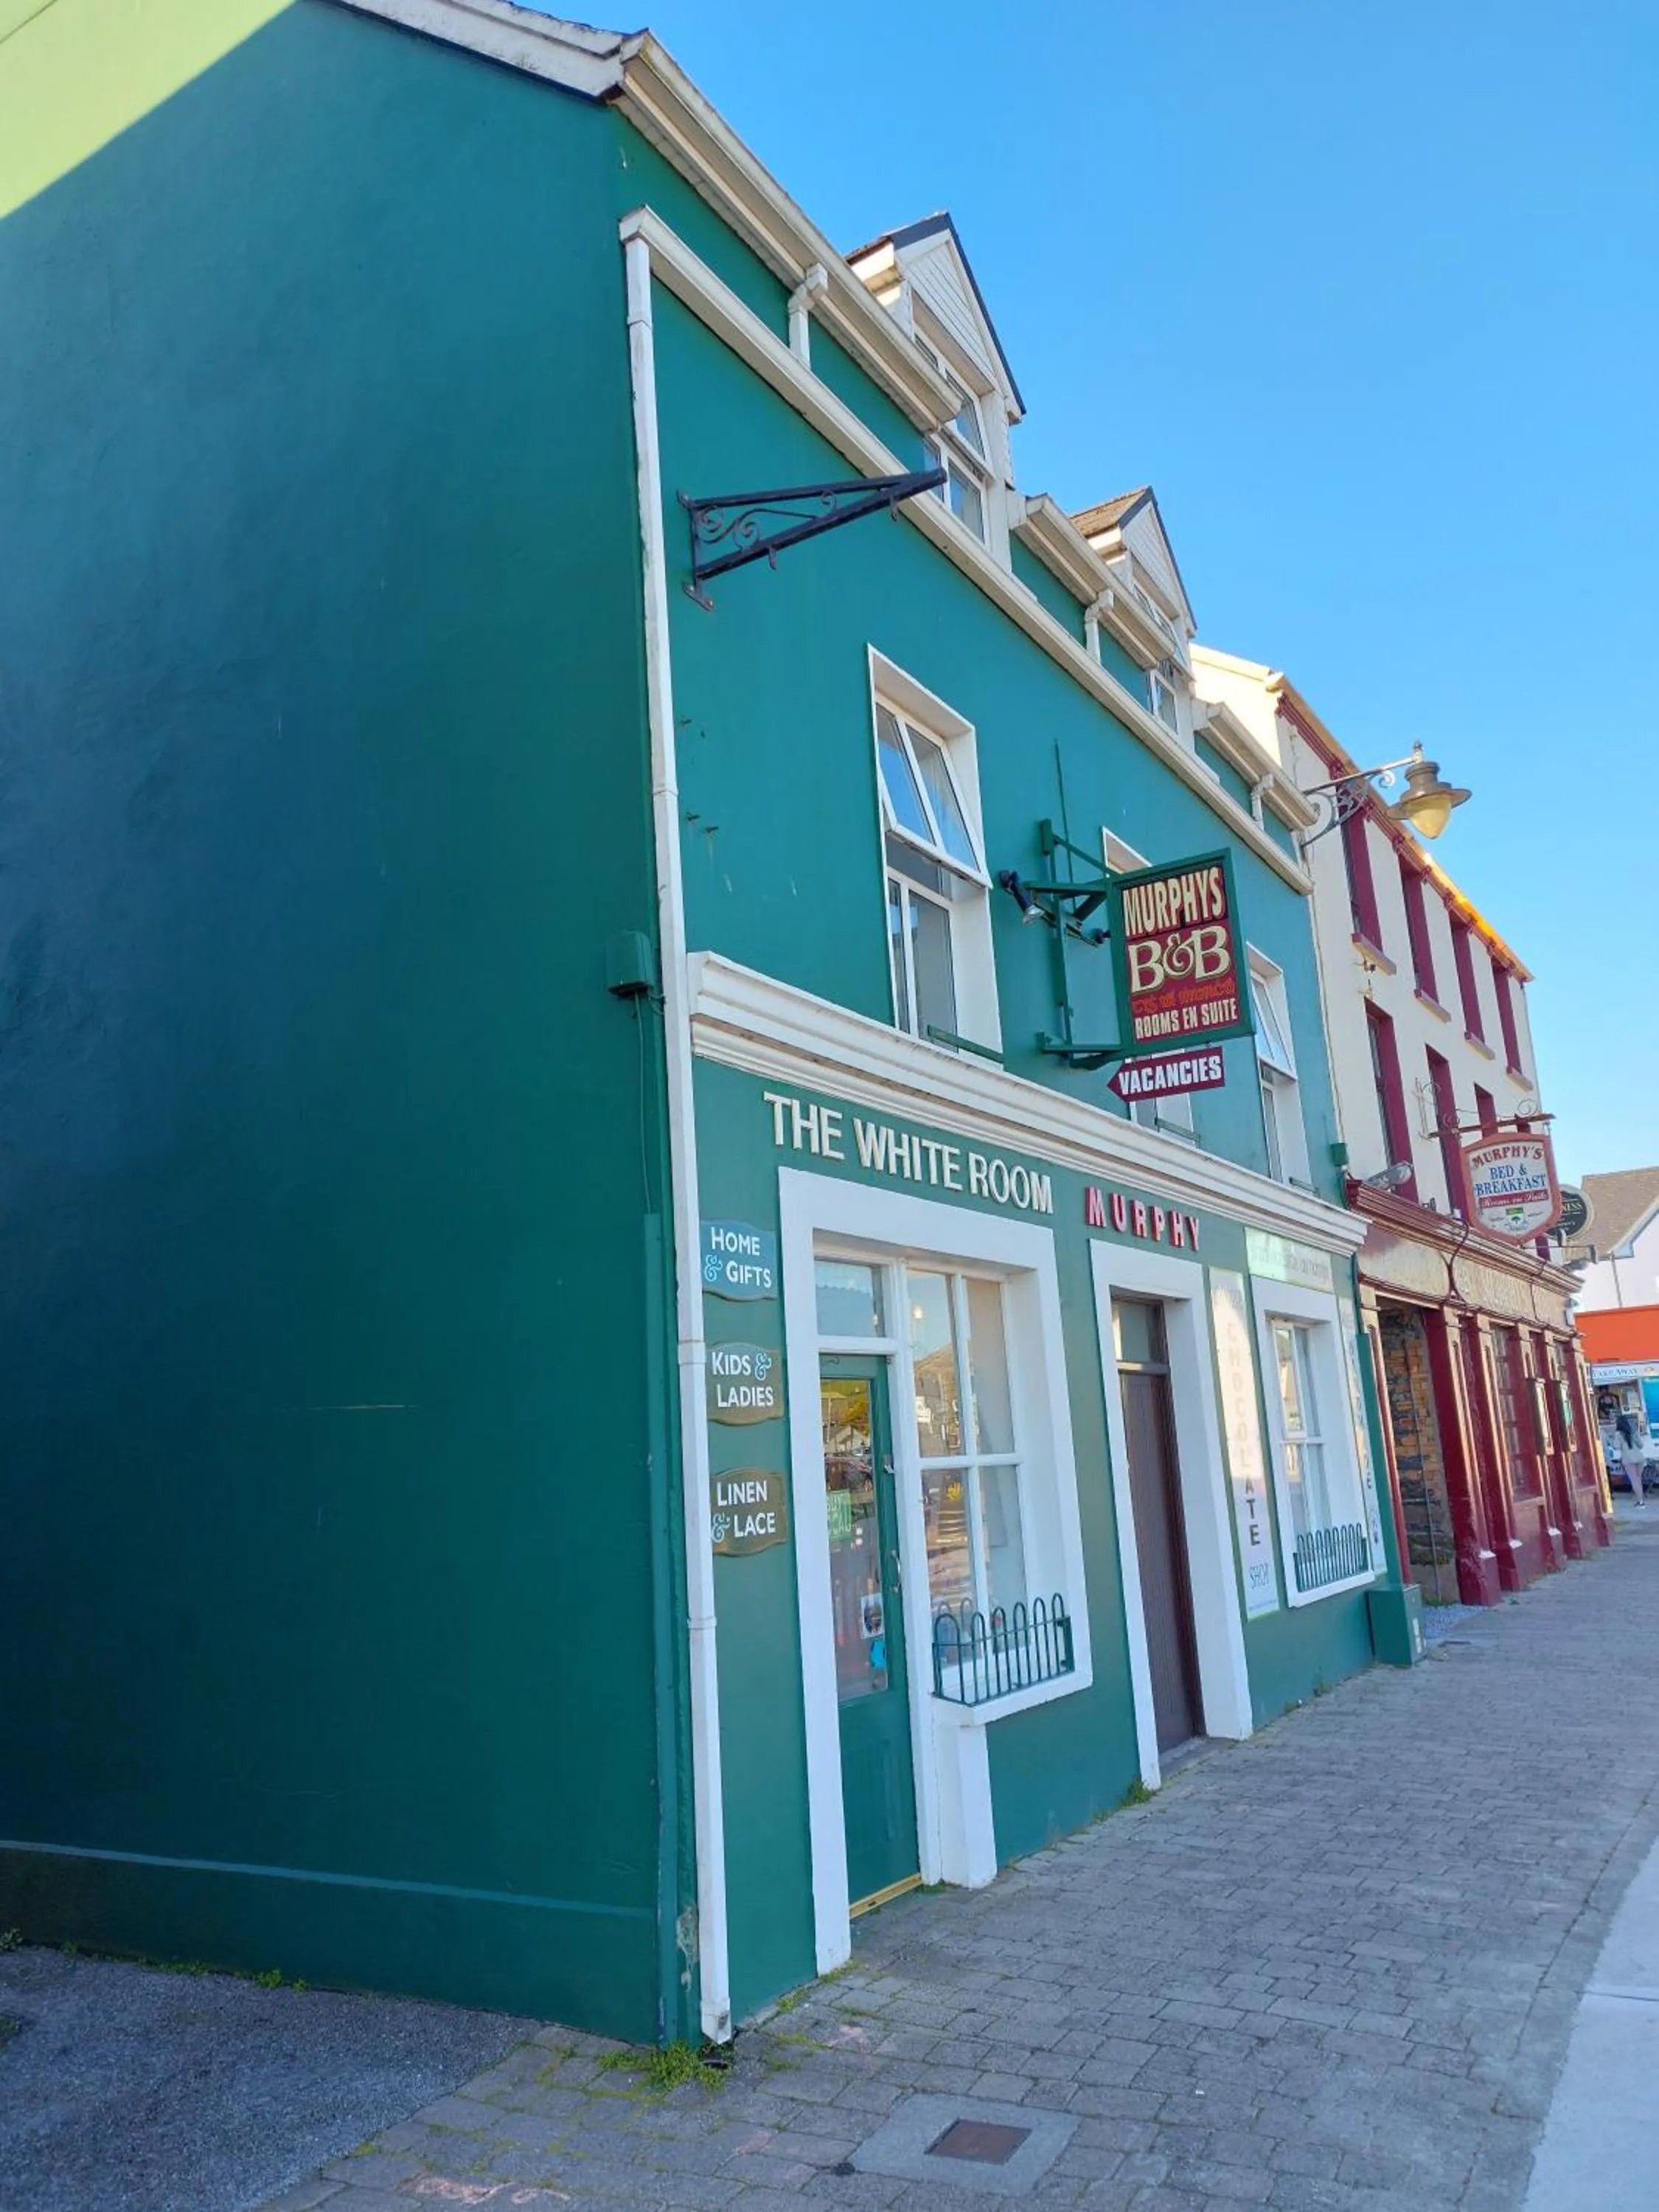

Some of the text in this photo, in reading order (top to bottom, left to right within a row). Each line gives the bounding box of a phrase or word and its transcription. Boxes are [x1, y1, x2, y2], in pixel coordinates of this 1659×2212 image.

[1123, 867, 1225, 936] MURPHYS
[1128, 925, 1231, 993] B&B
[1135, 998, 1238, 1040] ROOMS EN SUITE
[1119, 1055, 1222, 1095] VACANCIES
[763, 1091, 1054, 1214] THE WHITE ROOM
[1472, 1145, 1544, 1168] MURPHY'S
[1475, 1174, 1546, 1196] BREAKFAST
[1489, 1164, 1528, 1180] BED &
[1085, 1186, 1200, 1251] MURPHY
[711, 1227, 760, 1256] HOME
[704, 1254, 772, 1288] & GIFTS
[712, 1352, 771, 1381] KIDS &
[717, 1383, 774, 1408] LADIES
[1227, 1321, 1260, 1545] CHOCOLATE
[717, 1480, 768, 1506] LINEN
[712, 1512, 776, 1543] & LACE
